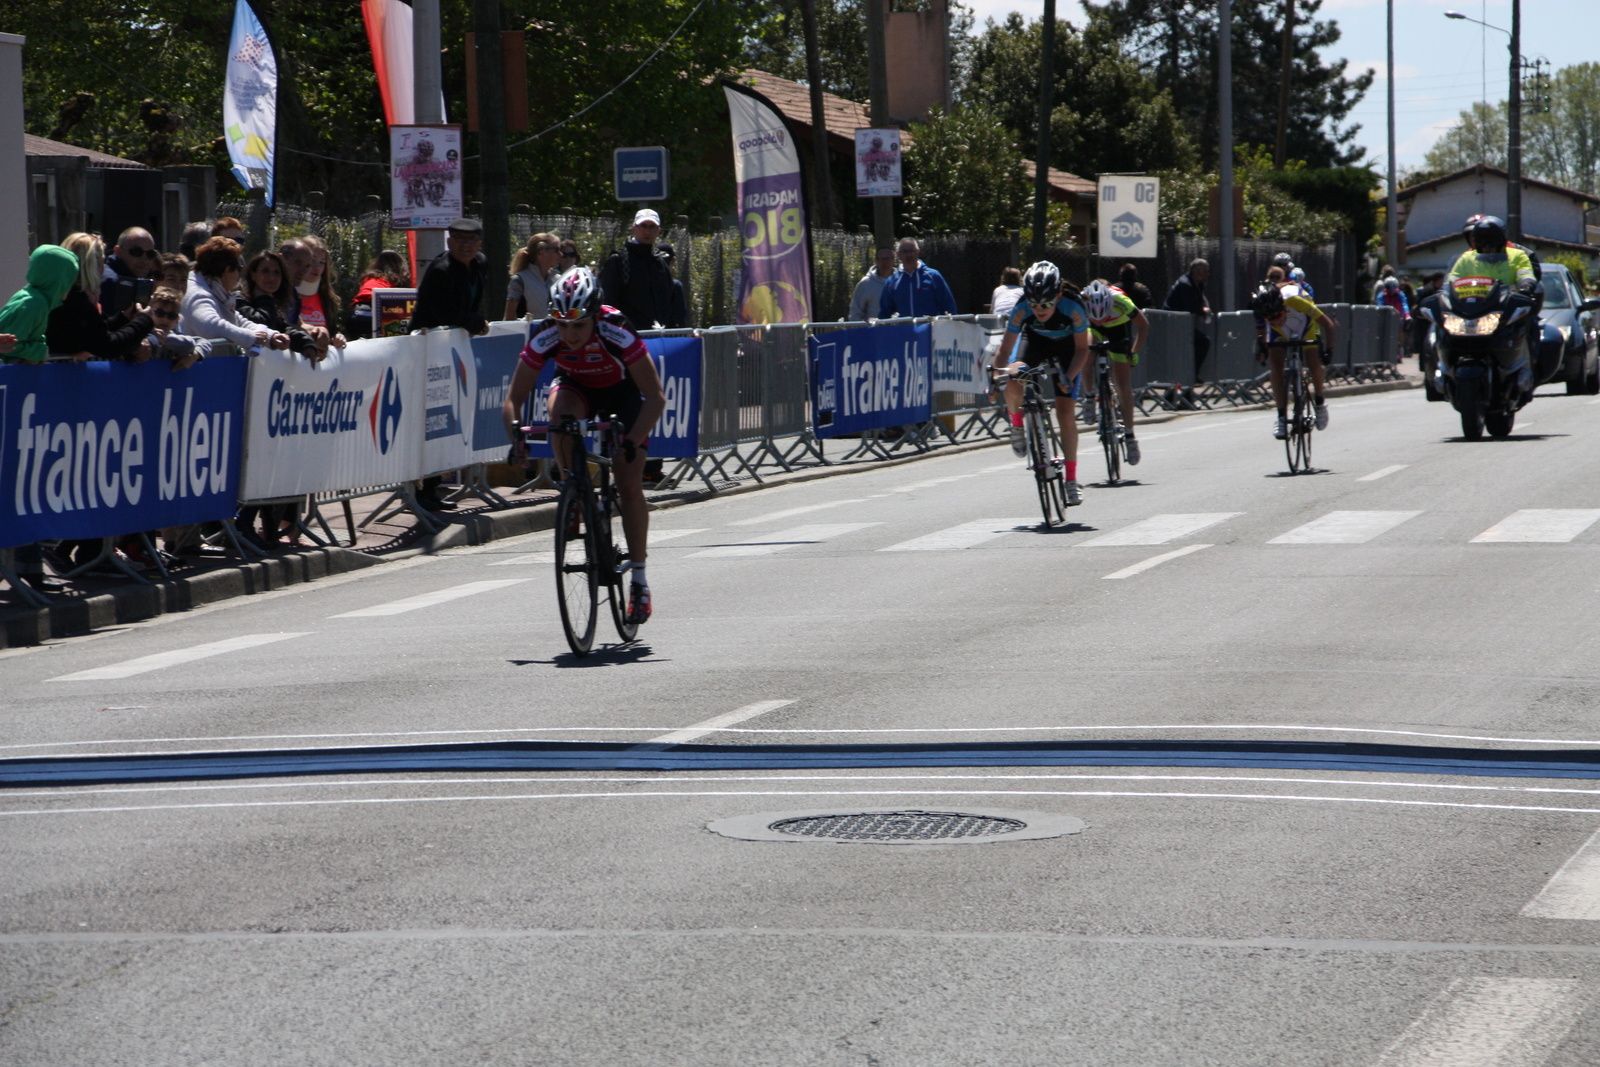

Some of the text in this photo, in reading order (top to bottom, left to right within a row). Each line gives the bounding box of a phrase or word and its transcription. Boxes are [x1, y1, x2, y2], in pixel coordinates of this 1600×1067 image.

[267, 378, 363, 438] Carrefour
[648, 355, 691, 438] leu
[842, 341, 929, 417] france bleu
[15, 387, 231, 516] france bleu
